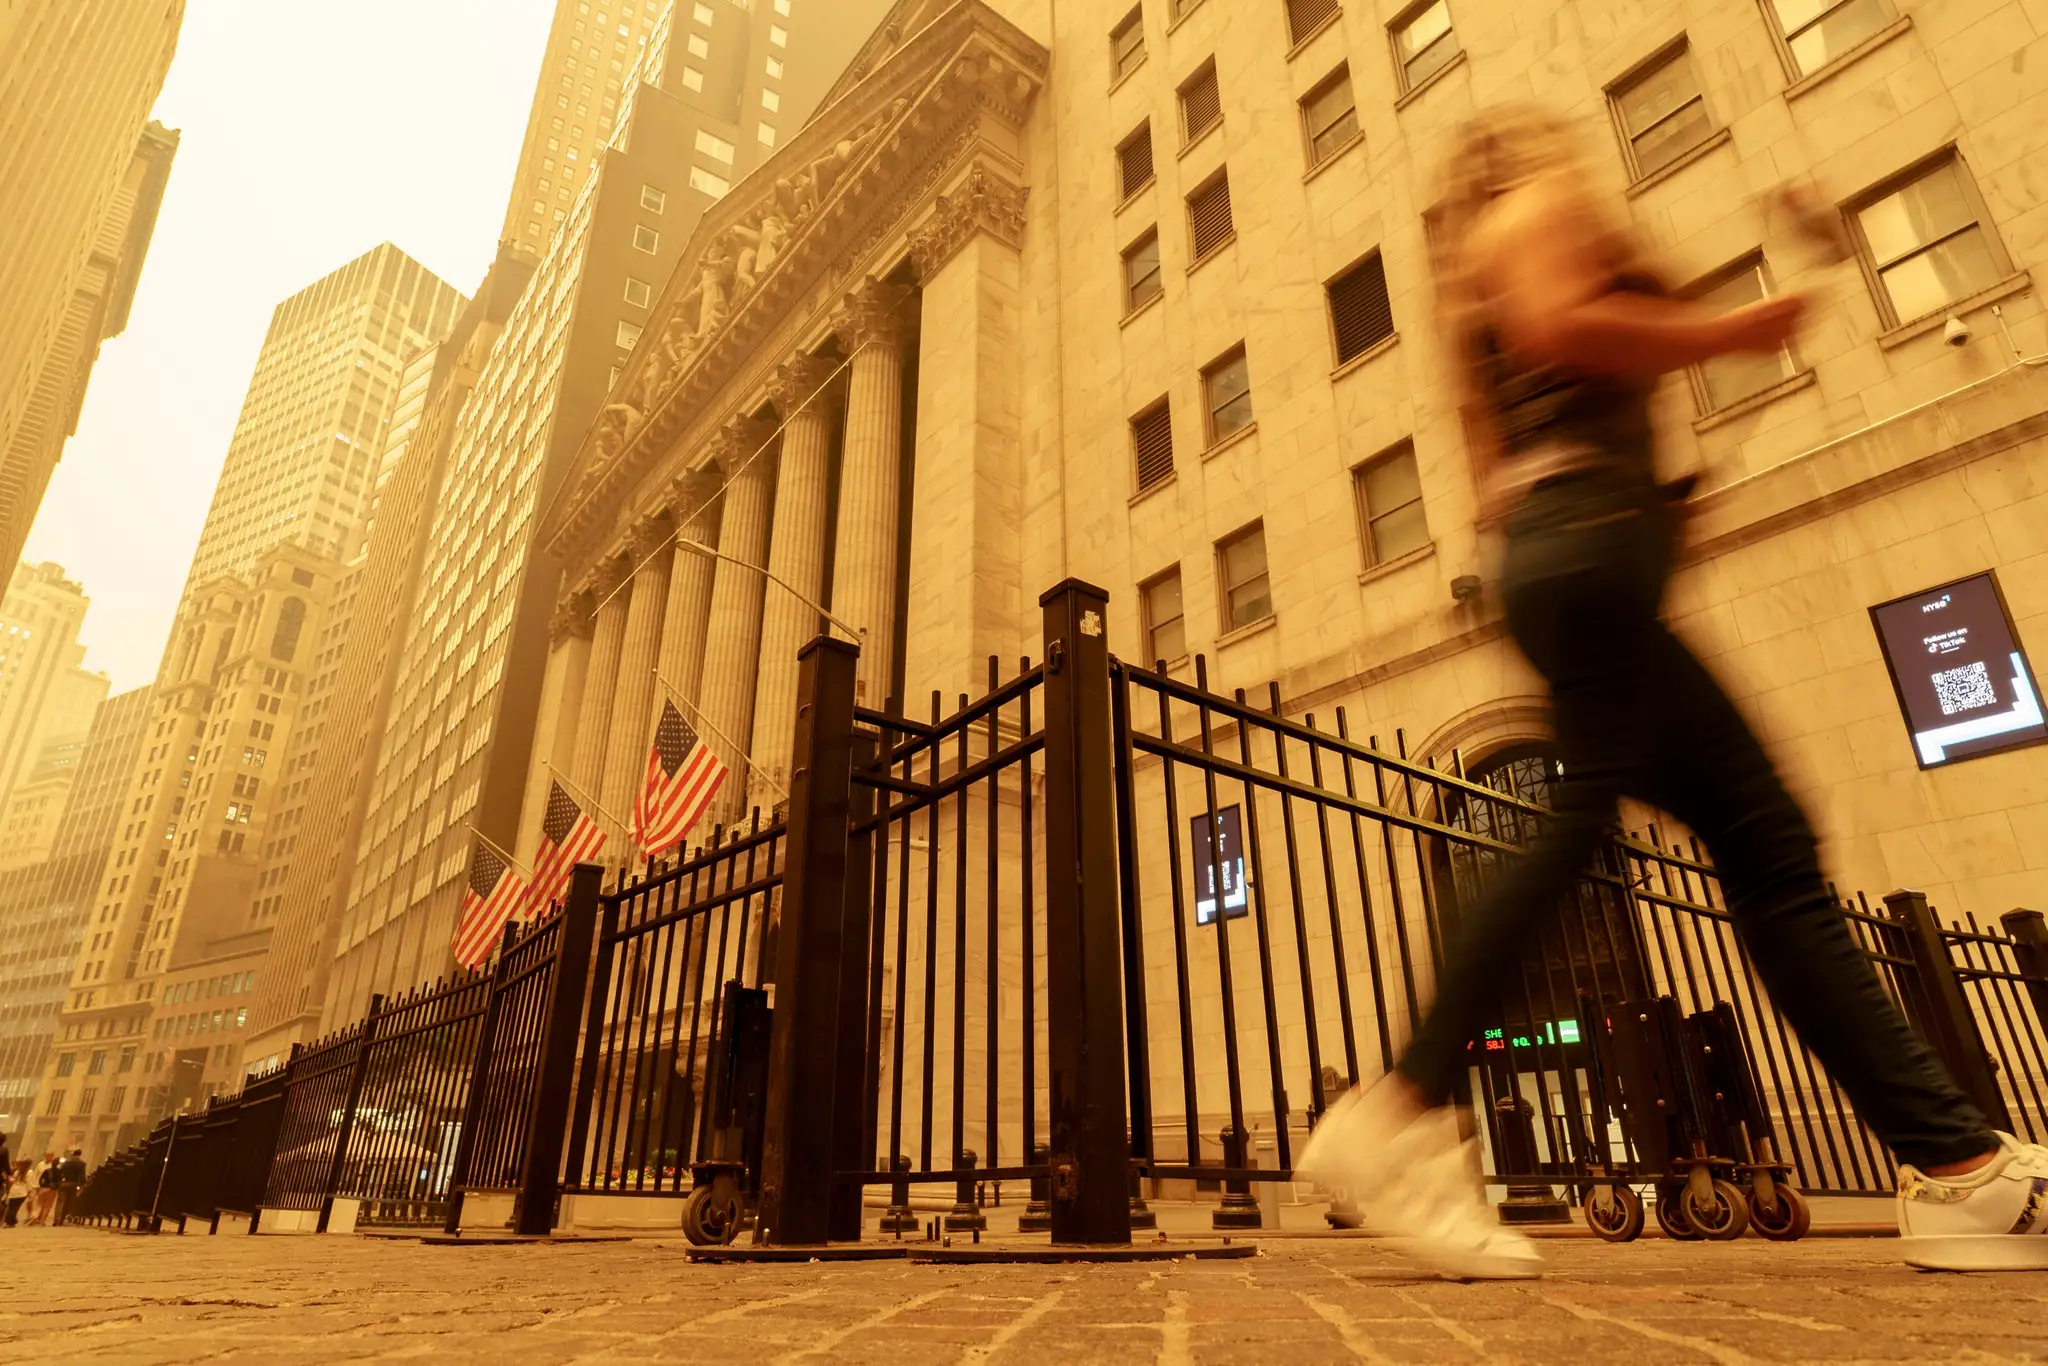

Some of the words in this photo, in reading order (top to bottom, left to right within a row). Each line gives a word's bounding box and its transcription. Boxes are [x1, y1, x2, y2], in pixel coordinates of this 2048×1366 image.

[1923, 635, 1947, 645] Follow
[1947, 630, 1957, 638] us
[1956, 627, 1968, 635] on
[1939, 637, 1966, 649] TikTok
[1484, 1028, 1503, 1039] SHE
[1485, 1039, 1505, 1050] 58.1
